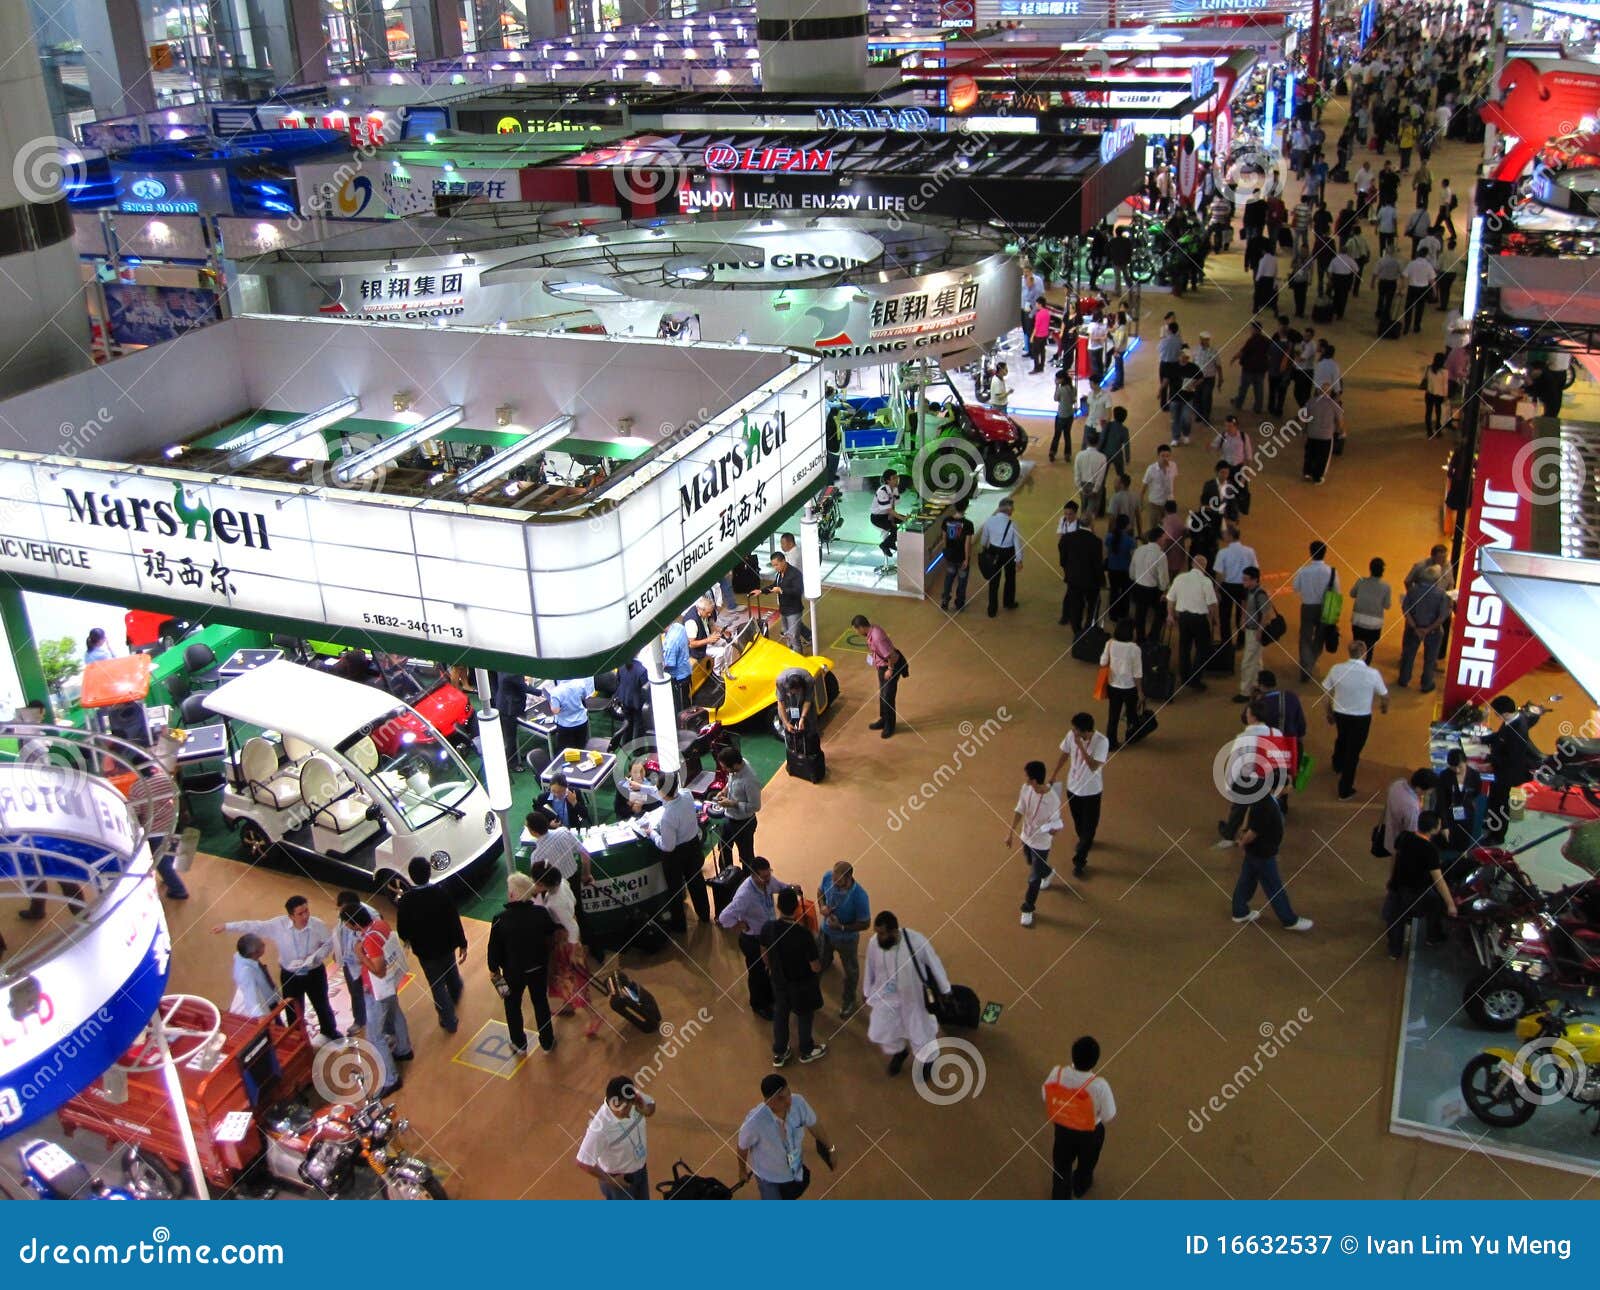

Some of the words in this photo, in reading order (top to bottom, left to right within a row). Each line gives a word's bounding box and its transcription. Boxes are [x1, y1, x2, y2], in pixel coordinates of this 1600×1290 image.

[740, 146, 833, 171] LIFAN
[679, 191, 734, 207] ENJOY
[868, 195, 905, 211] LIFE
[361, 273, 463, 300] 银翔集团
[406, 307, 465, 320] GROUP
[871, 283, 979, 328] 银翔集团
[915, 326, 976, 347] GROUP
[719, 480, 767, 542] 玛西尔
[17, 541, 92, 569] VEHICLE
[142, 549, 237, 597] 玛西尔
[628, 568, 675, 621] ELECTRIC
[676, 536, 714, 577] VEHICLE
